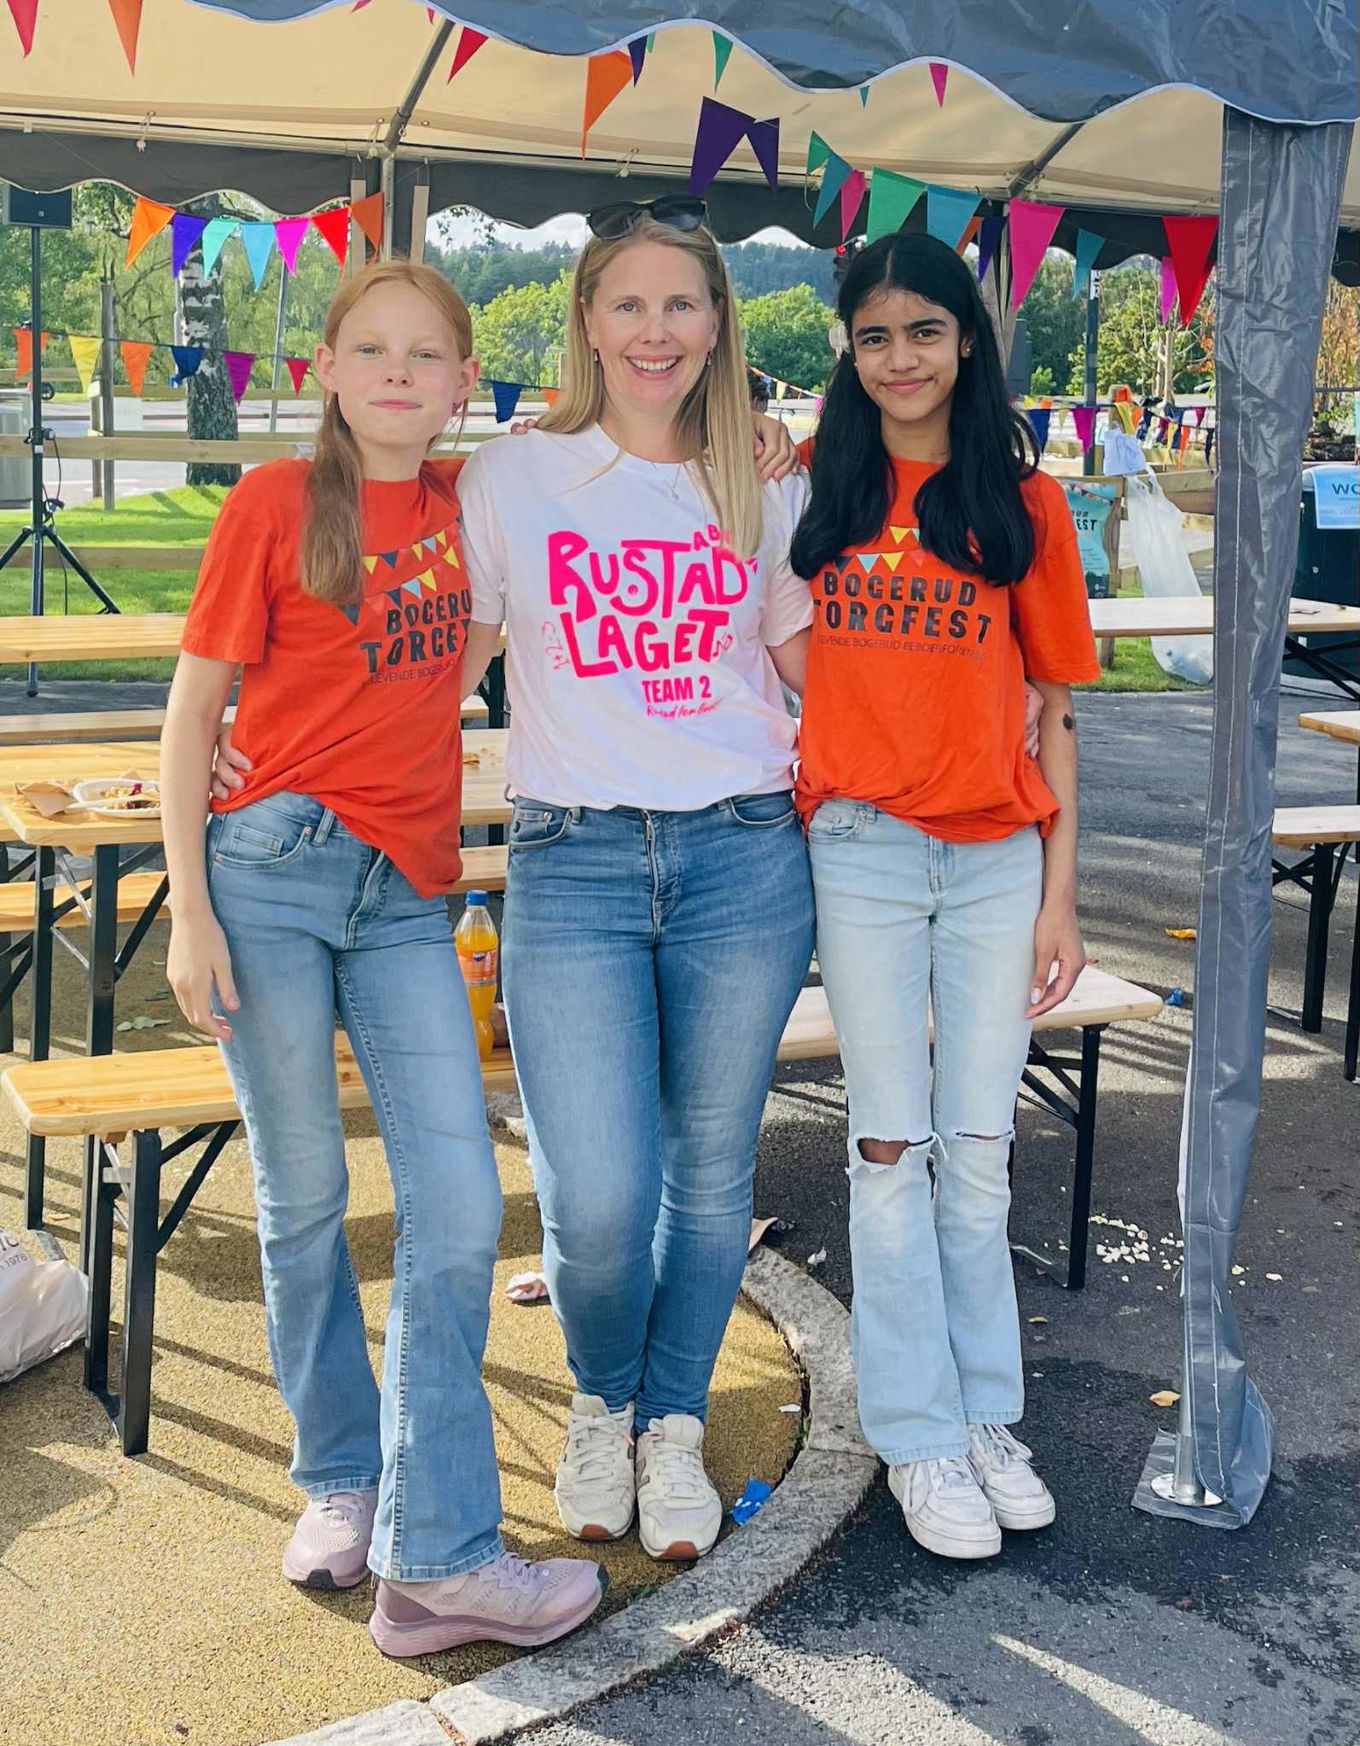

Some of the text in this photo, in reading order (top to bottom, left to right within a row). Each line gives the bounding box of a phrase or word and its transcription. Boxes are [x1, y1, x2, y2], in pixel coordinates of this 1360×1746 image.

[693, 523, 732, 551] AB
[548, 530, 748, 623] RUSTAD
[824, 571, 977, 607] BOGERUD
[560, 608, 730, 678] LAGET
[641, 675, 712, 702] TEAM 2
